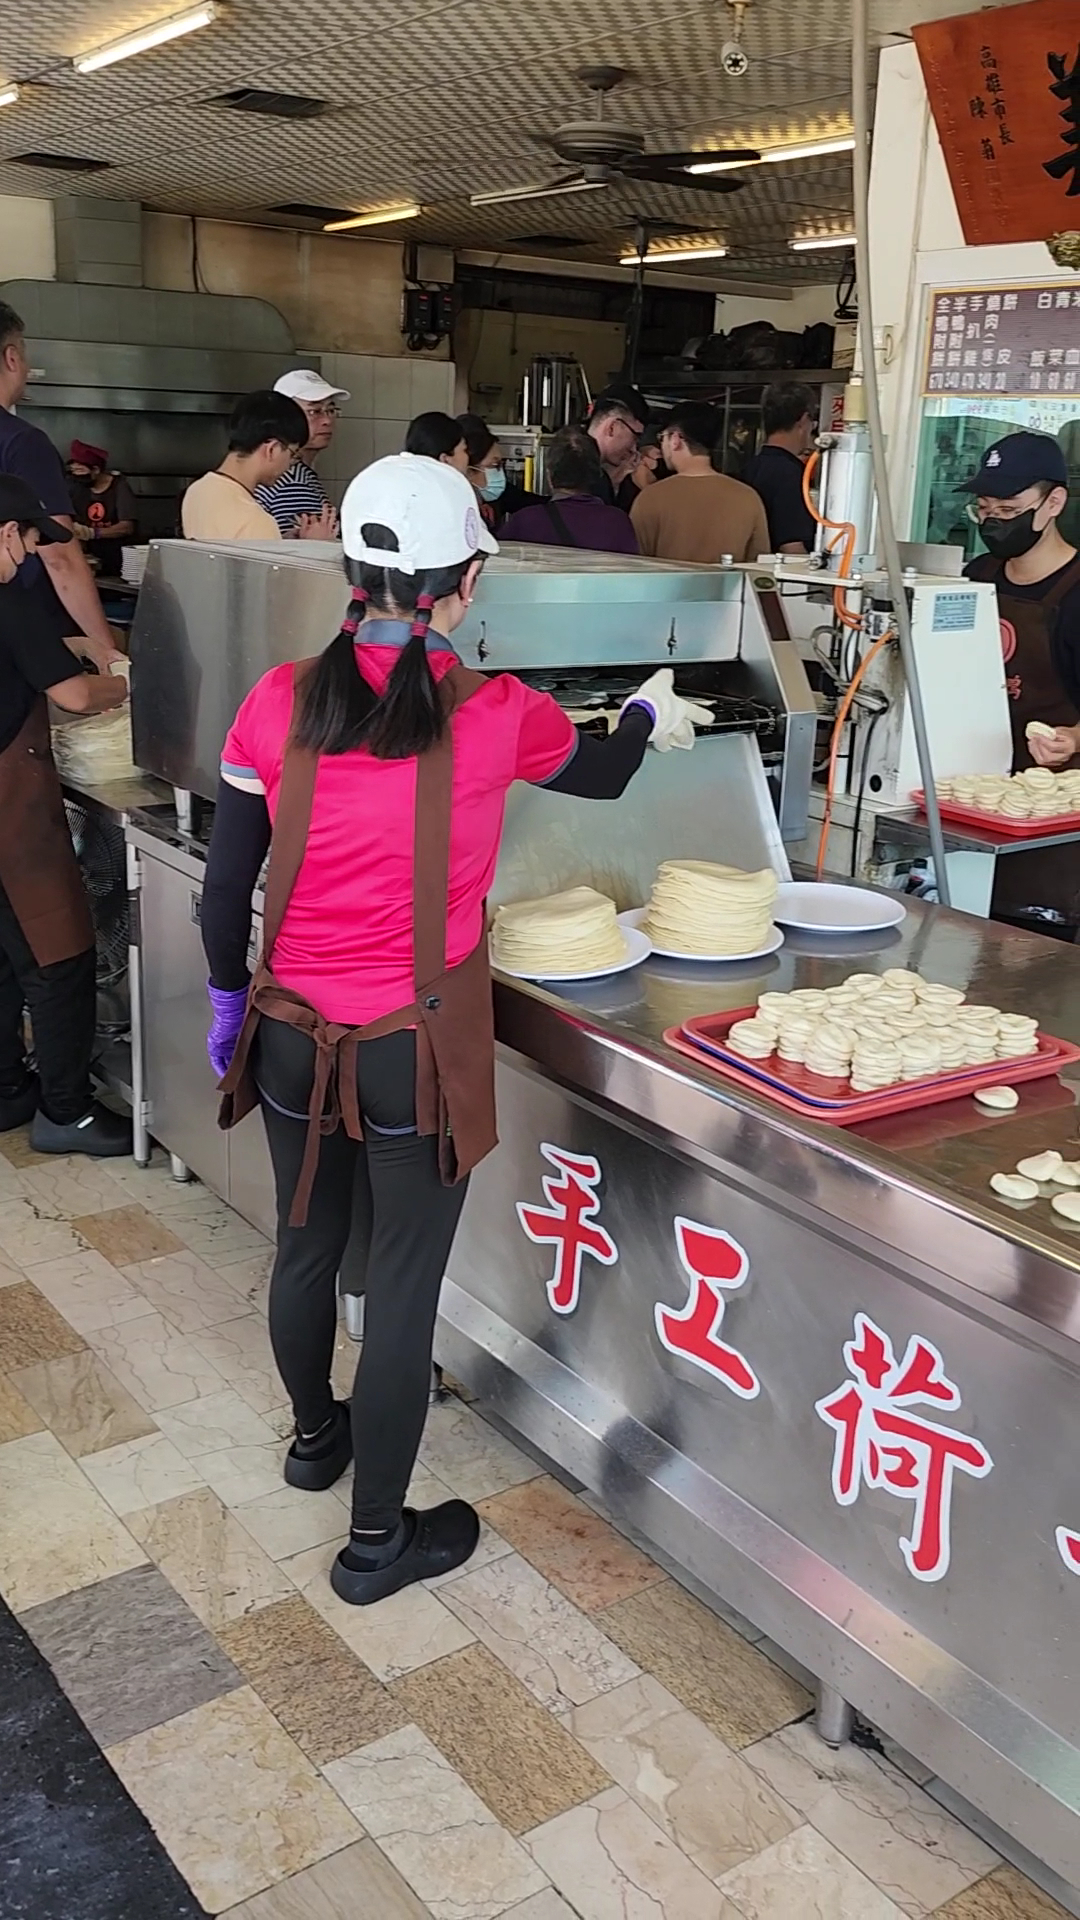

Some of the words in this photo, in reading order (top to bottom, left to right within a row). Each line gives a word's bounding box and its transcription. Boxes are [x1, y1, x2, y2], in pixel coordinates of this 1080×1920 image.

[969, 95, 996, 160] 陳菊
[980, 45, 1015, 145] 高雄市長
